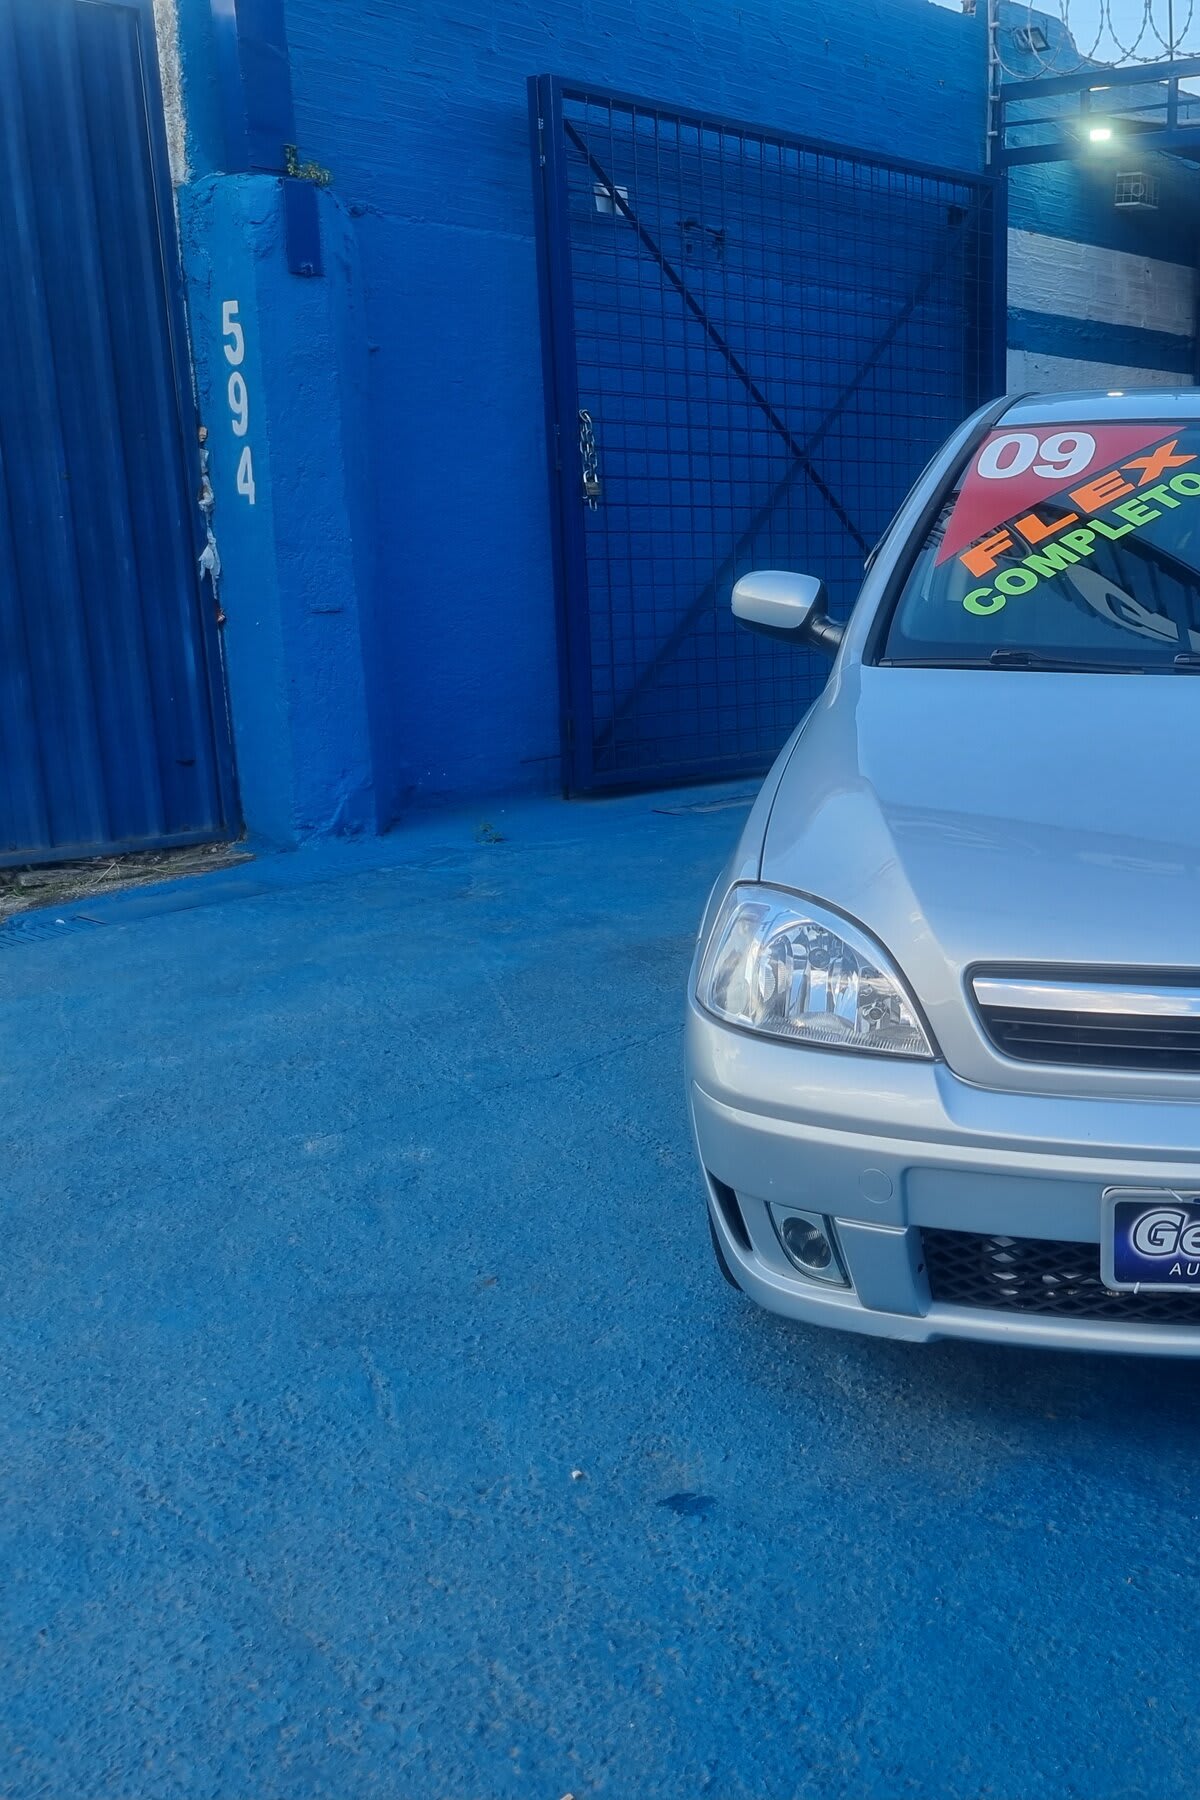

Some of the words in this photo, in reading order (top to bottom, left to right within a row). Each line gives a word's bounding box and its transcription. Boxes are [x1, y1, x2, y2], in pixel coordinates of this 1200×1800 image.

[222, 300, 256, 505] 594
[977, 431, 1096, 479] 09
[959, 439, 1198, 578] FLEX
